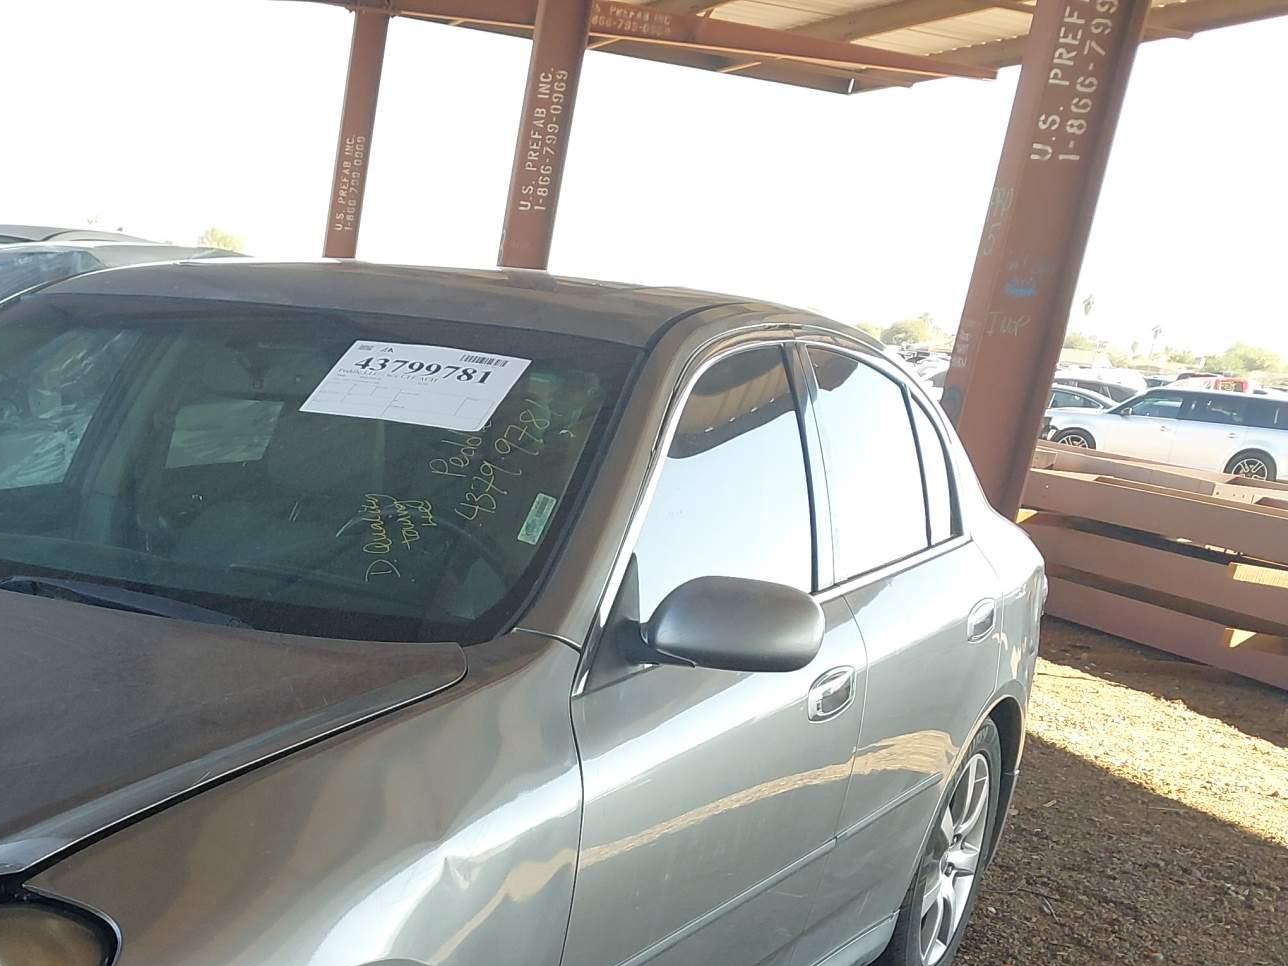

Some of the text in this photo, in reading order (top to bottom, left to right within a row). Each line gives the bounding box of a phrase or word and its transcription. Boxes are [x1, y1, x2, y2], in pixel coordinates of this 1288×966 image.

[1030, 0, 1090, 161] U.S. PREF
[338, 161, 352, 204] PREFAB
[518, 67, 554, 211] U.S. PREFAB INC.
[533, 70, 568, 211] 1-866-799-0969
[335, 210, 346, 231] U.S.
[354, 356, 493, 385] 43799781
